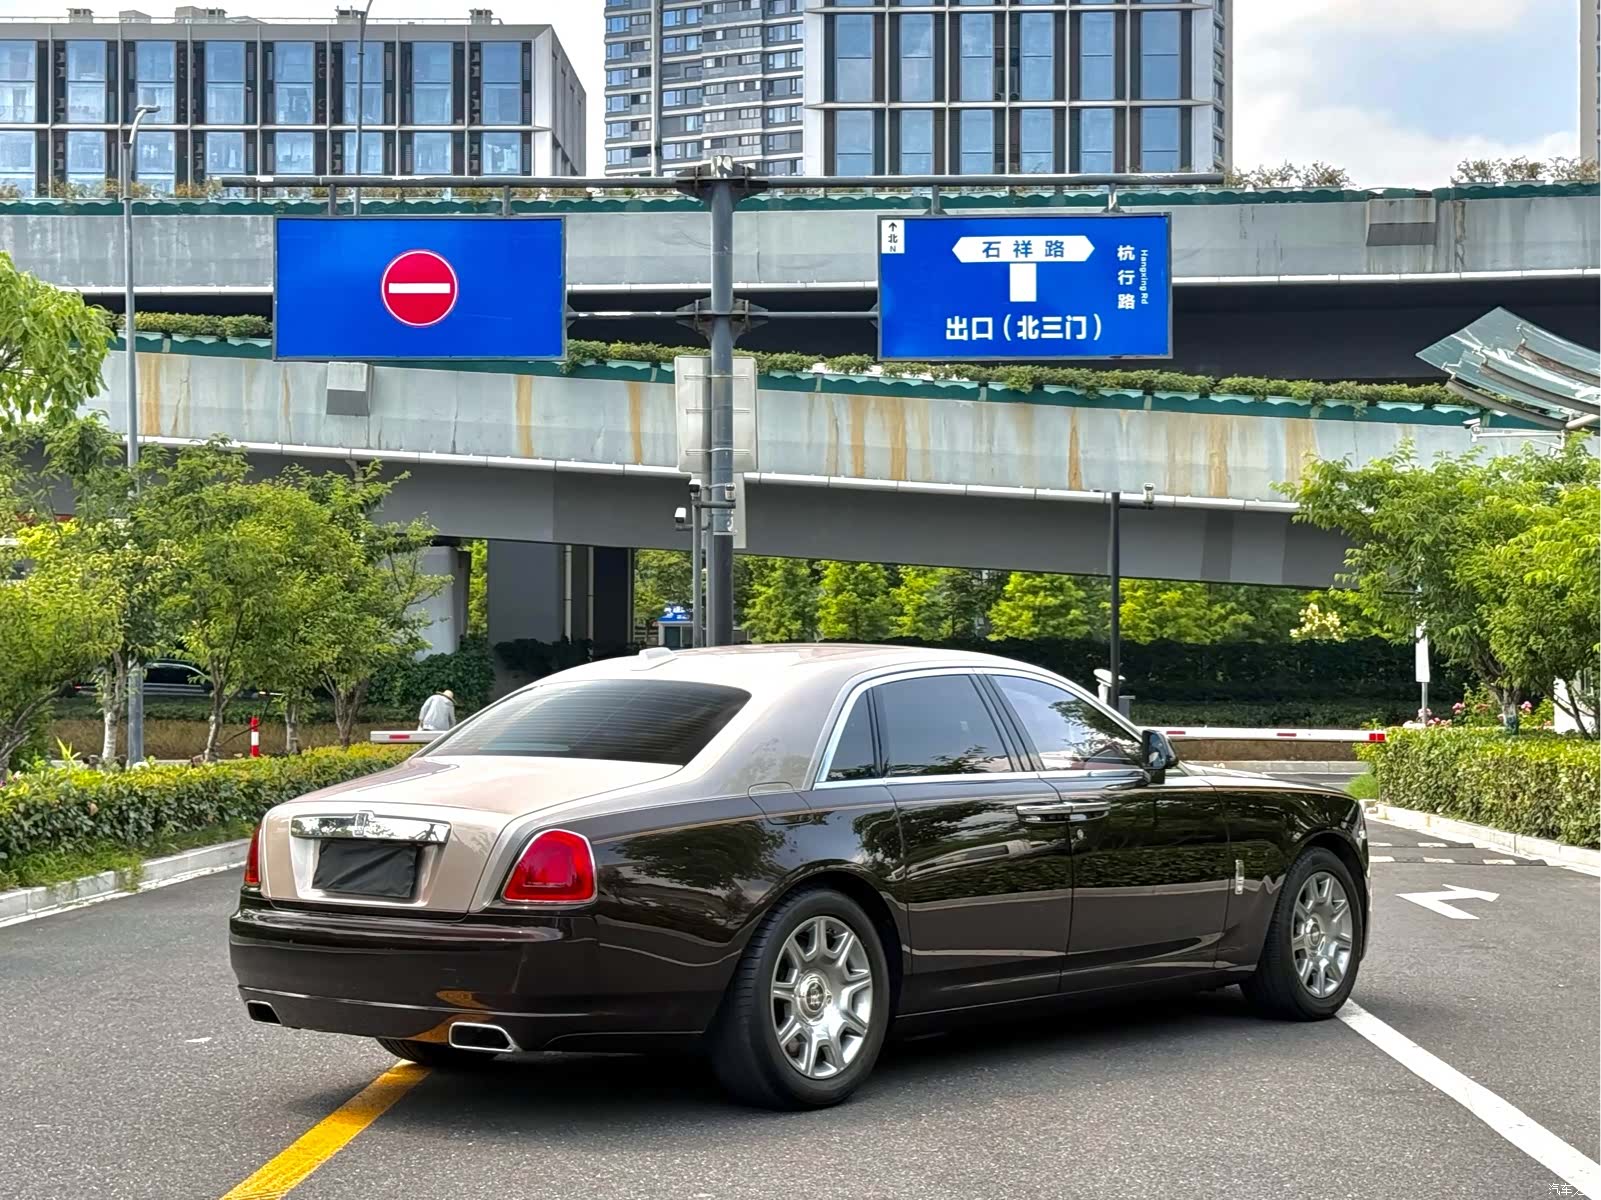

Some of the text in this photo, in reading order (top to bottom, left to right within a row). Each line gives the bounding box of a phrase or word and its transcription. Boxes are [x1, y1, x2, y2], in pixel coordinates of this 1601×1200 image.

[887, 233, 898, 244] 北
[889, 245, 896, 253] N
[982, 240, 1065, 258] 石祥路
[1117, 245, 1135, 310] 杭行路
[1139, 249, 1149, 305] Hangxing Rd
[945, 313, 1103, 341] 出口（北三门）
